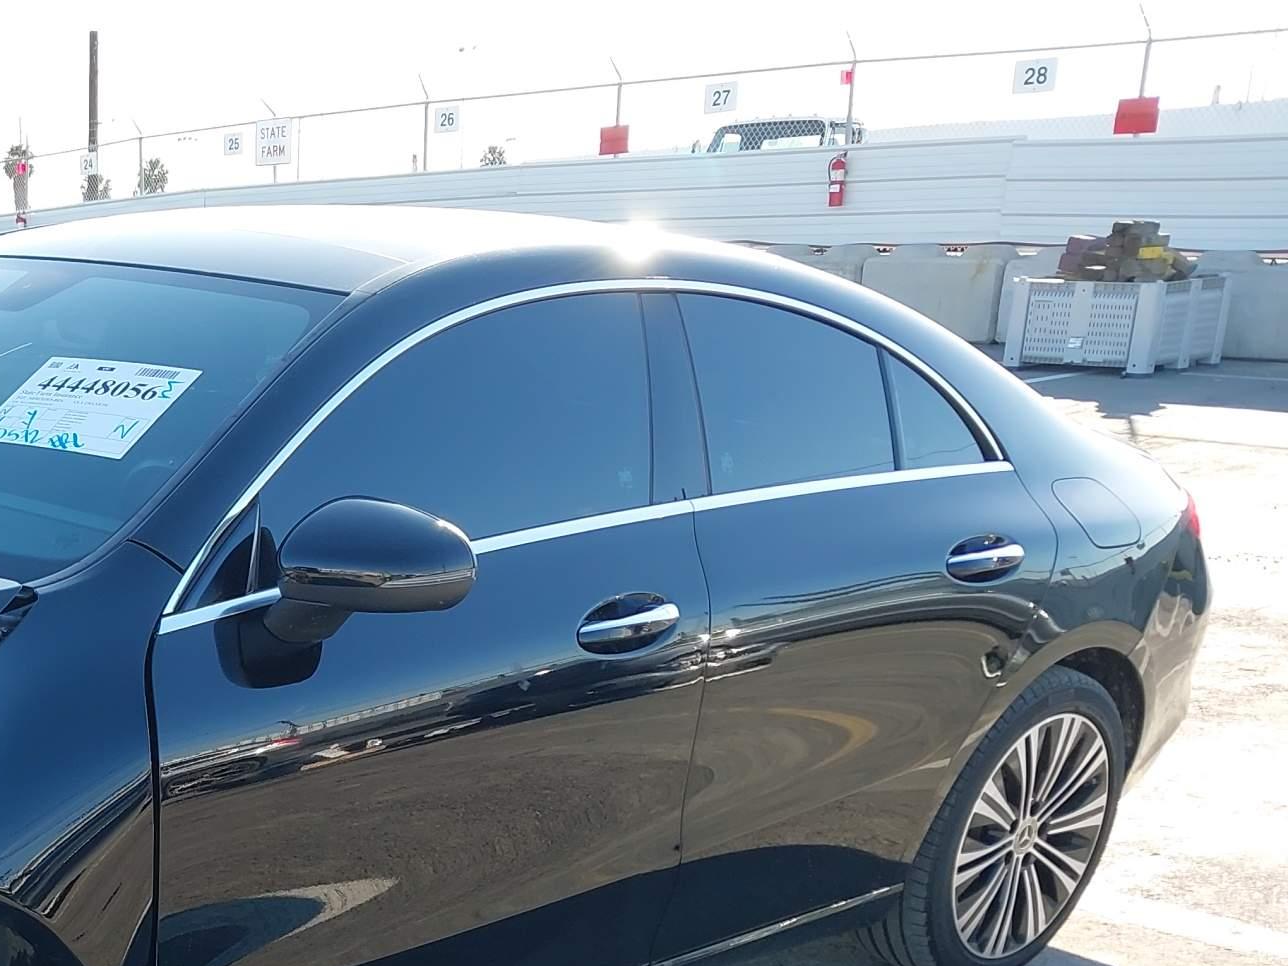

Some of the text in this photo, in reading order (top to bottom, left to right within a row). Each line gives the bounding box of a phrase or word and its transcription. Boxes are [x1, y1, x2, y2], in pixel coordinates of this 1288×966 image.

[1023, 66, 1048, 85] 28
[712, 90, 731, 106] 27
[440, 112, 454, 127] 26
[260, 125, 287, 140] STATE
[228, 138, 240, 151] 25
[261, 145, 286, 159] FARM
[83, 159, 93, 170] 24
[38, 375, 165, 401] 44448056
